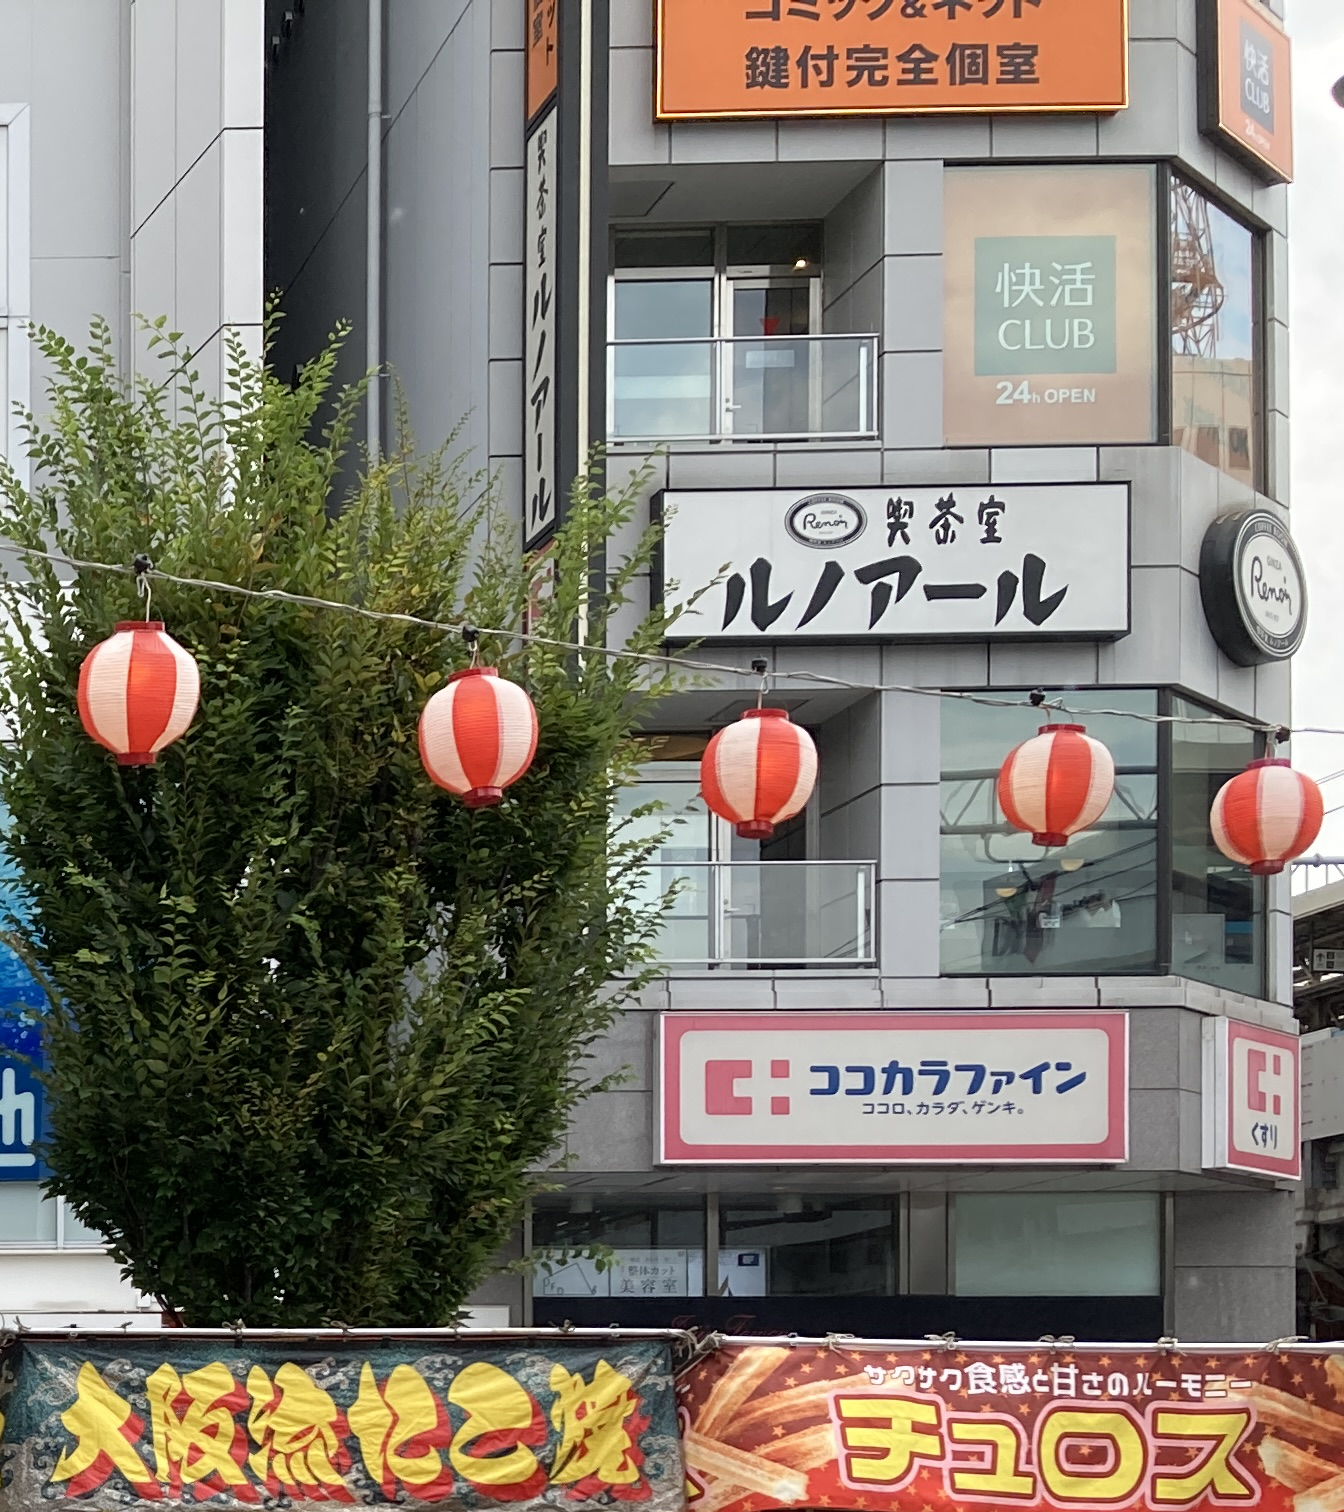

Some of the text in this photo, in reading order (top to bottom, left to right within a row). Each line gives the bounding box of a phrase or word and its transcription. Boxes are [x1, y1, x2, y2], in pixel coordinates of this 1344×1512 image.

[745, 42, 1041, 90] 鍵付完全個室
[995, 261, 1096, 308] 快活
[998, 318, 1095, 350] CLUB
[1044, 388, 1096, 403] OPEN
[886, 492, 1007, 547] 喫茶室
[722, 552, 1069, 633] ルノアール
[809, 1059, 1088, 1096] ココカラファイン
[862, 1101, 1025, 1115] ココロ、カラダ、ゲンキ。
[1251, 1122, 1278, 1150] くすり
[620, 1278, 678, 1295] 美容室
[864, 1362, 1253, 1400] サクサク食感と甘さのハーモニー
[836, 1394, 1254, 1503] チュロス
